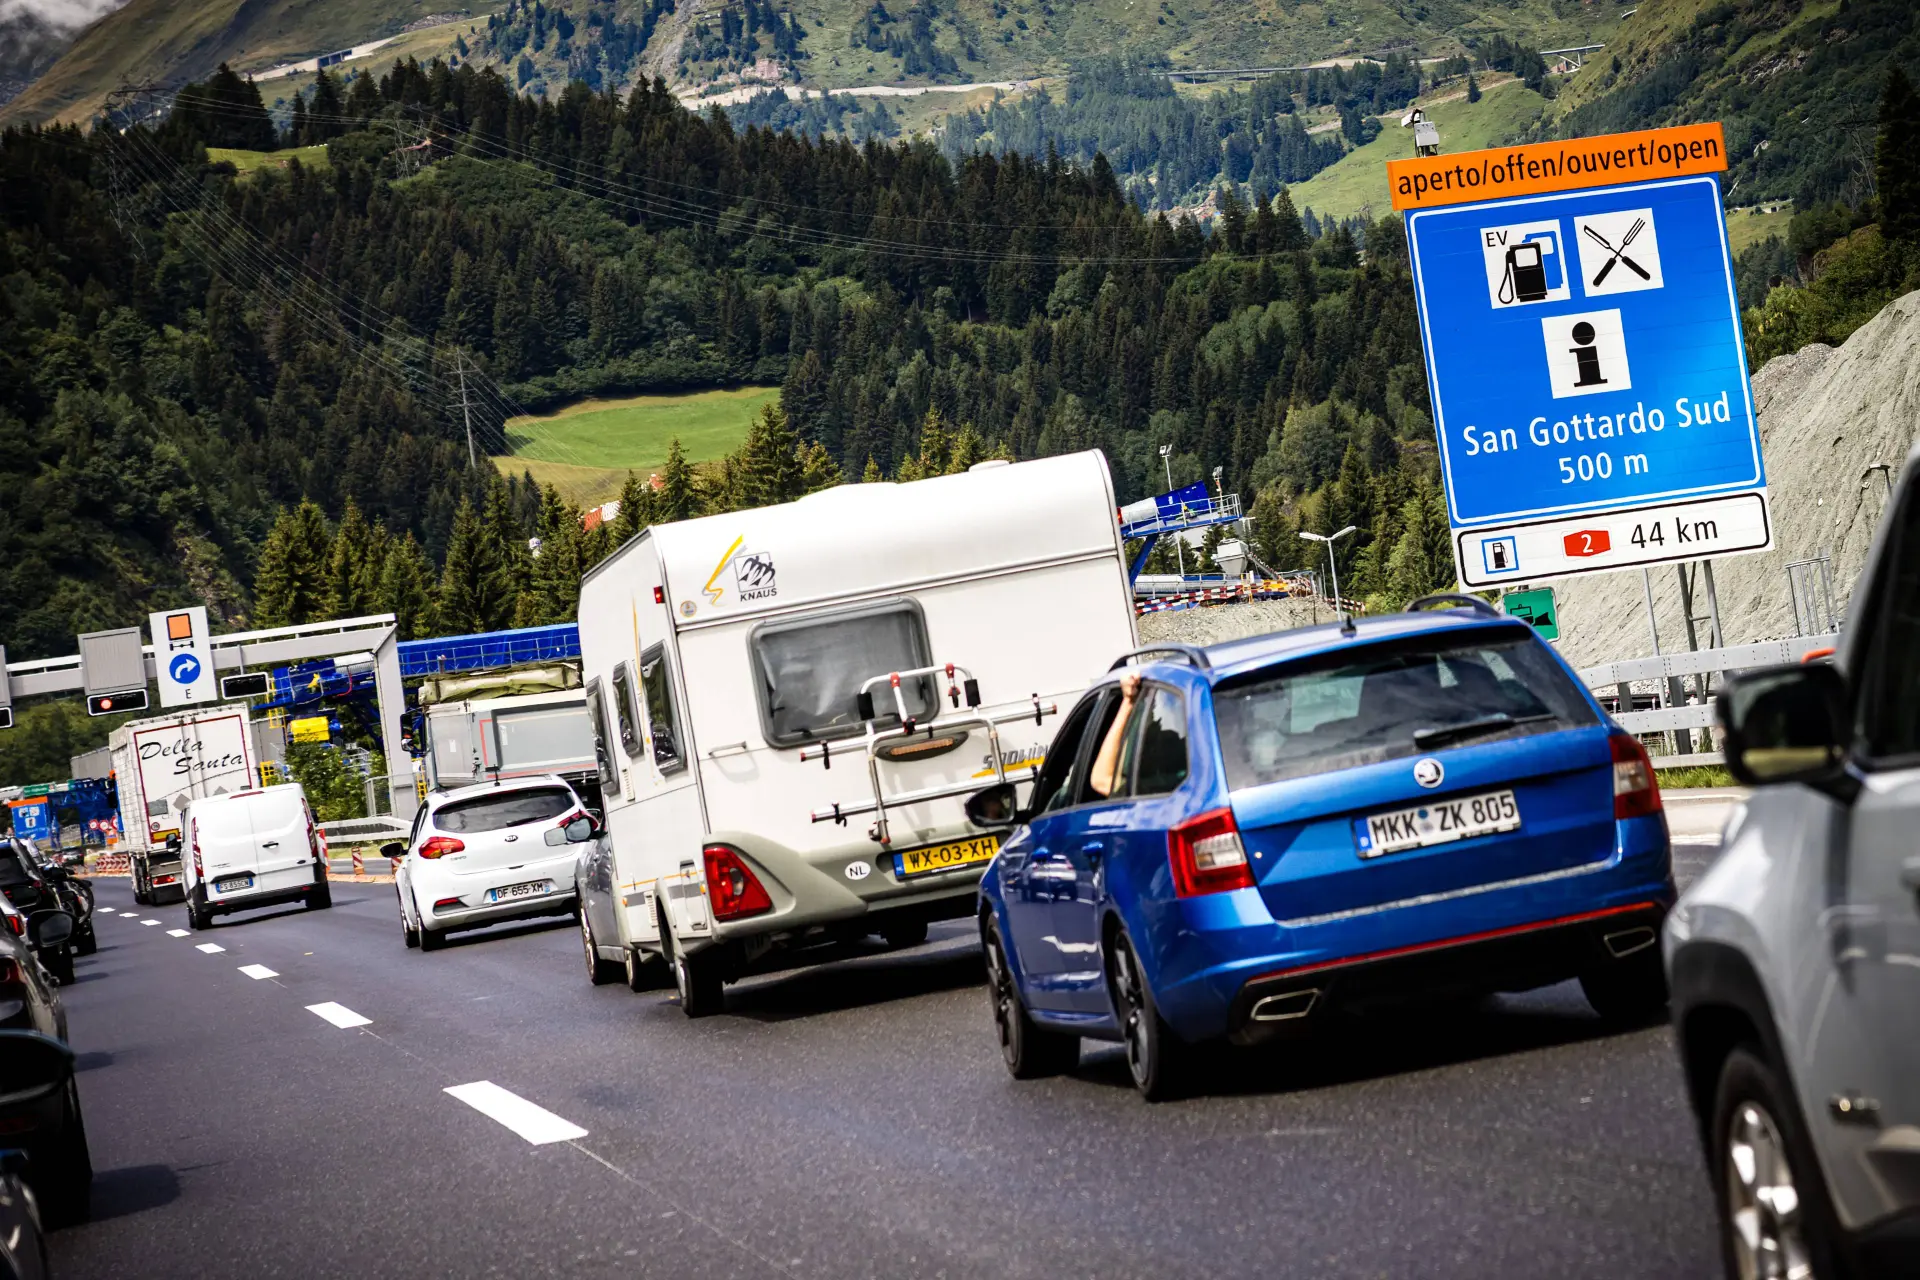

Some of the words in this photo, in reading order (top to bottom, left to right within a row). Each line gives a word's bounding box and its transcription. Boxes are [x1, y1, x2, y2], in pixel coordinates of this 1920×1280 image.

[1398, 137, 1719, 201] aperto/offen/ouvert/open
[1485, 230, 1509, 248] EV
[1463, 425, 1518, 456] San
[1529, 402, 1665, 447] Gottardo
[1675, 391, 1731, 429] Sud
[1559, 452, 1612, 484] 500
[1624, 452, 1649, 475] m
[1580, 533, 1594, 554] 2
[1631, 522, 1665, 549] 44
[1675, 517, 1719, 544] km
[740, 588, 778, 602] KNAUS
[185, 689, 192, 699] E
[138, 738, 205, 761] Della
[173, 754, 243, 775] Santa
[1371, 812, 1419, 845] MKK
[1435, 803, 1467, 832] ZK
[1472, 794, 1515, 824] 805
[908, 839, 995, 870] WX-03-XH
[849, 866, 867, 877] NL
